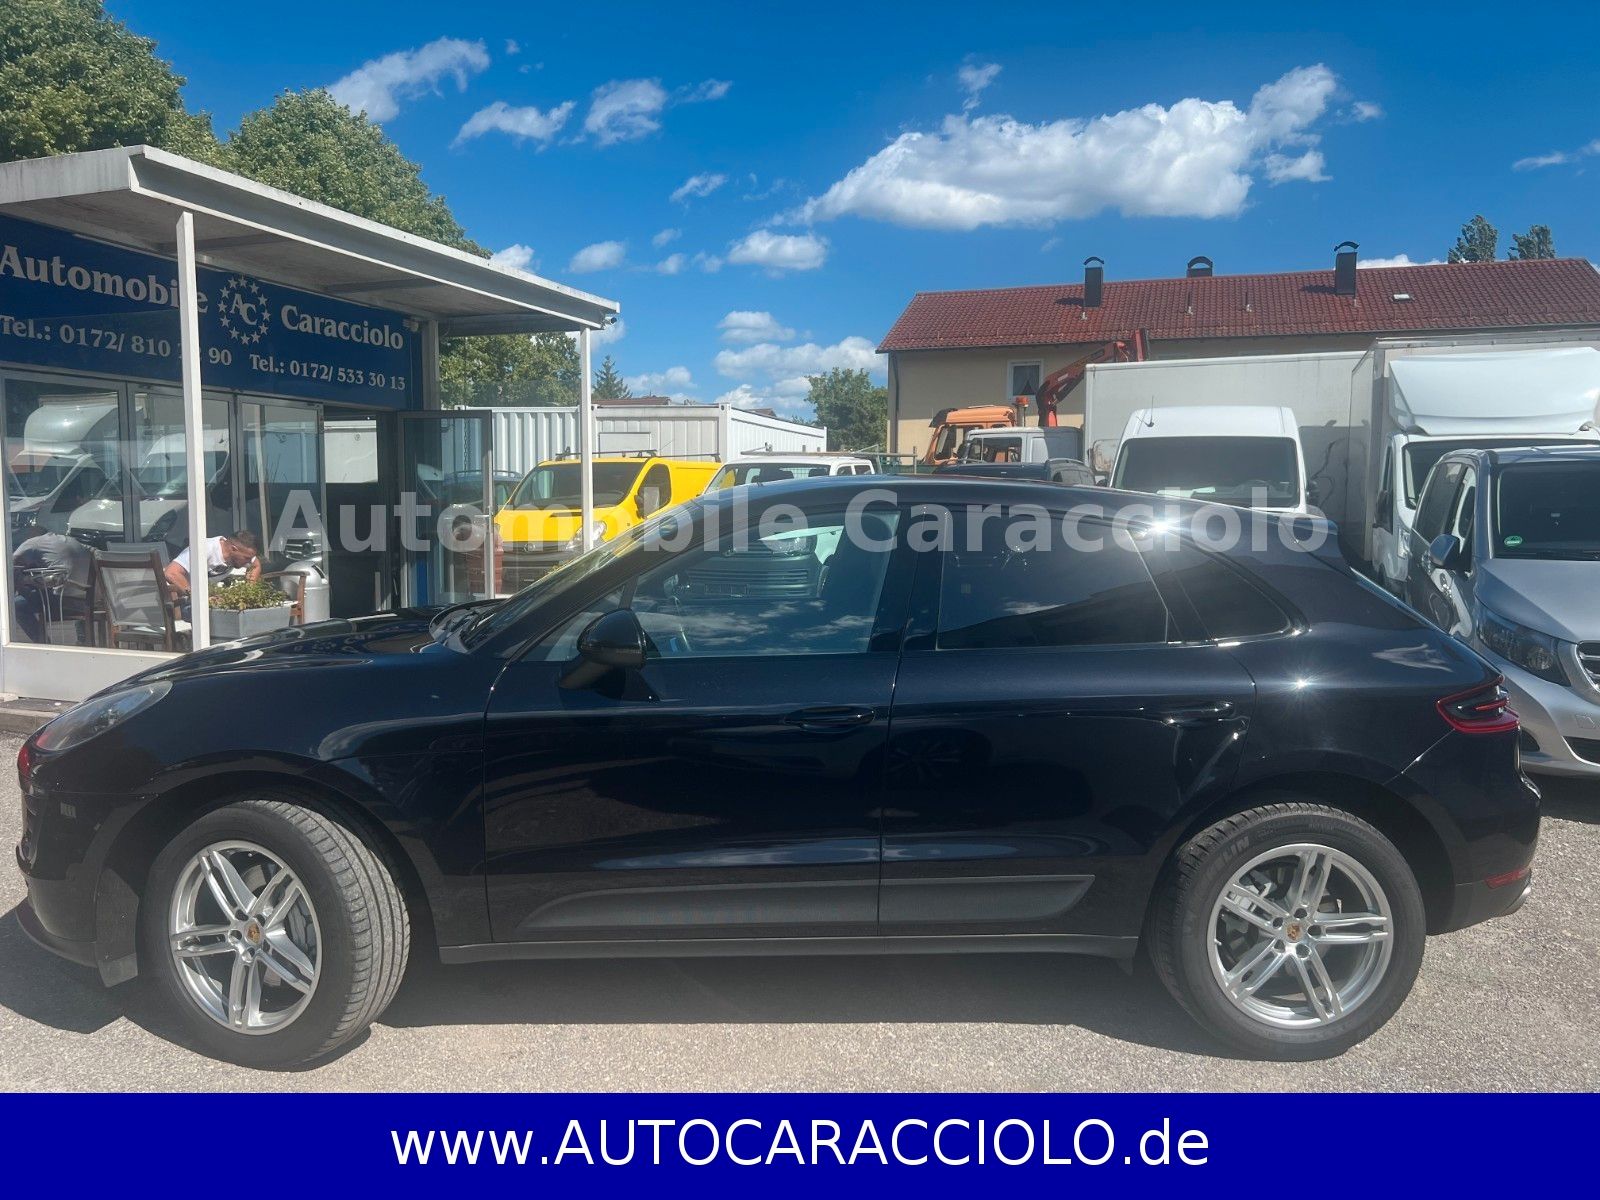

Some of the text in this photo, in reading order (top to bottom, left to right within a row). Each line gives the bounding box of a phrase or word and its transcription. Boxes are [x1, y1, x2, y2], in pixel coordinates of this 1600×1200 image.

[0, 245, 209, 313] Automobie
[281, 304, 404, 350] Caracciolo
[0, 314, 51, 341] Tel.:
[59, 324, 125, 352] 0172/
[131, 335, 171, 357] 810
[208, 347, 232, 366] 90
[250, 353, 285, 374] Tel.:
[289, 360, 333, 382] 0172/
[337, 367, 364, 385] 533
[368, 371, 385, 388] 30
